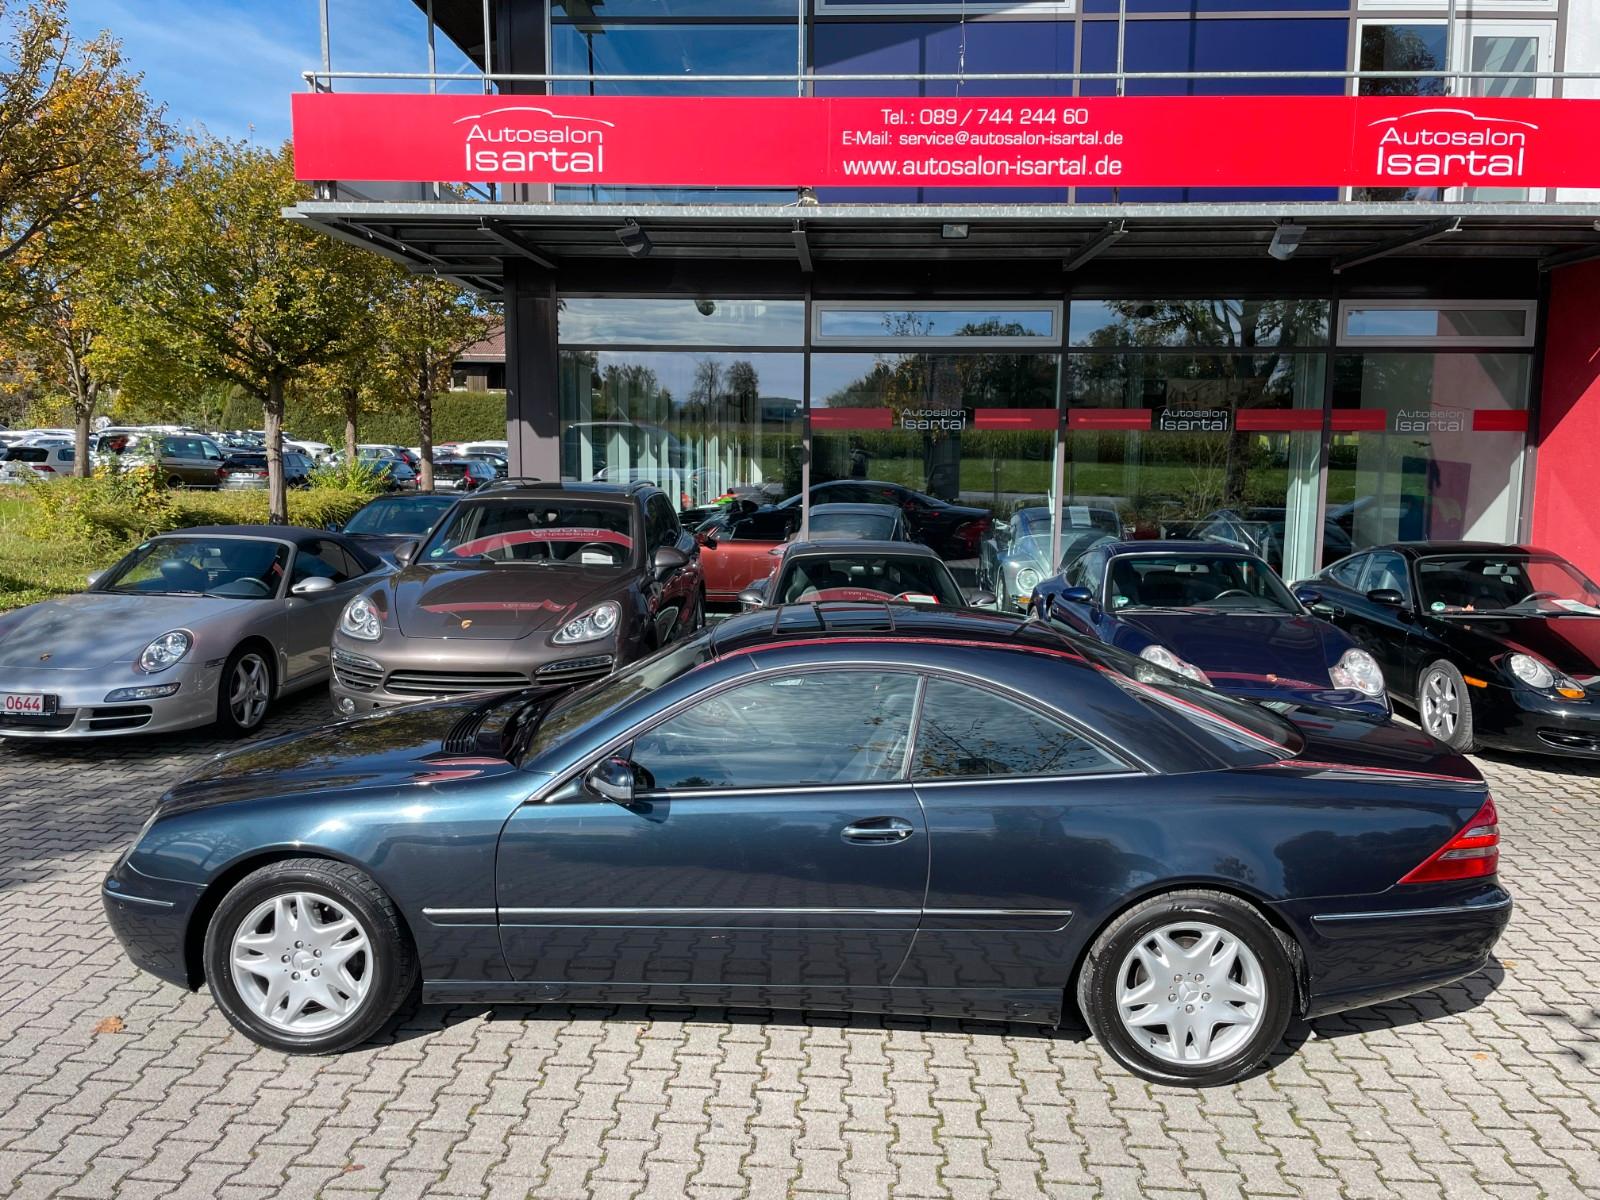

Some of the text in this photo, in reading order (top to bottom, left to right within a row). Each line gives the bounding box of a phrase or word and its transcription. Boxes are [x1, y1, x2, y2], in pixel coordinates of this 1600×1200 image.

[881, 108, 915, 125] Tel.:
[920, 108, 958, 125] 089
[977, 109, 1014, 125] 744
[1020, 109, 1056, 125] 244
[1063, 109, 1089, 125] 60
[466, 124, 603, 143] Autosalon
[842, 131, 1124, 146] E-Mail: service@autosalon-isartal.de
[1380, 127, 1526, 146] Autosalon
[465, 143, 604, 173] Isartal
[843, 155, 1123, 176] www.autosalon-isartal.de
[1376, 146, 1525, 176] Isartal
[902, 407, 966, 417] Autosalon
[1161, 408, 1228, 418] Autosalon
[1397, 409, 1465, 418] Autosalon
[901, 416, 966, 430] Isartal
[1160, 417, 1228, 431] Isartal
[1395, 418, 1464, 432] Isartal
[6, 695, 41, 711] 0644
